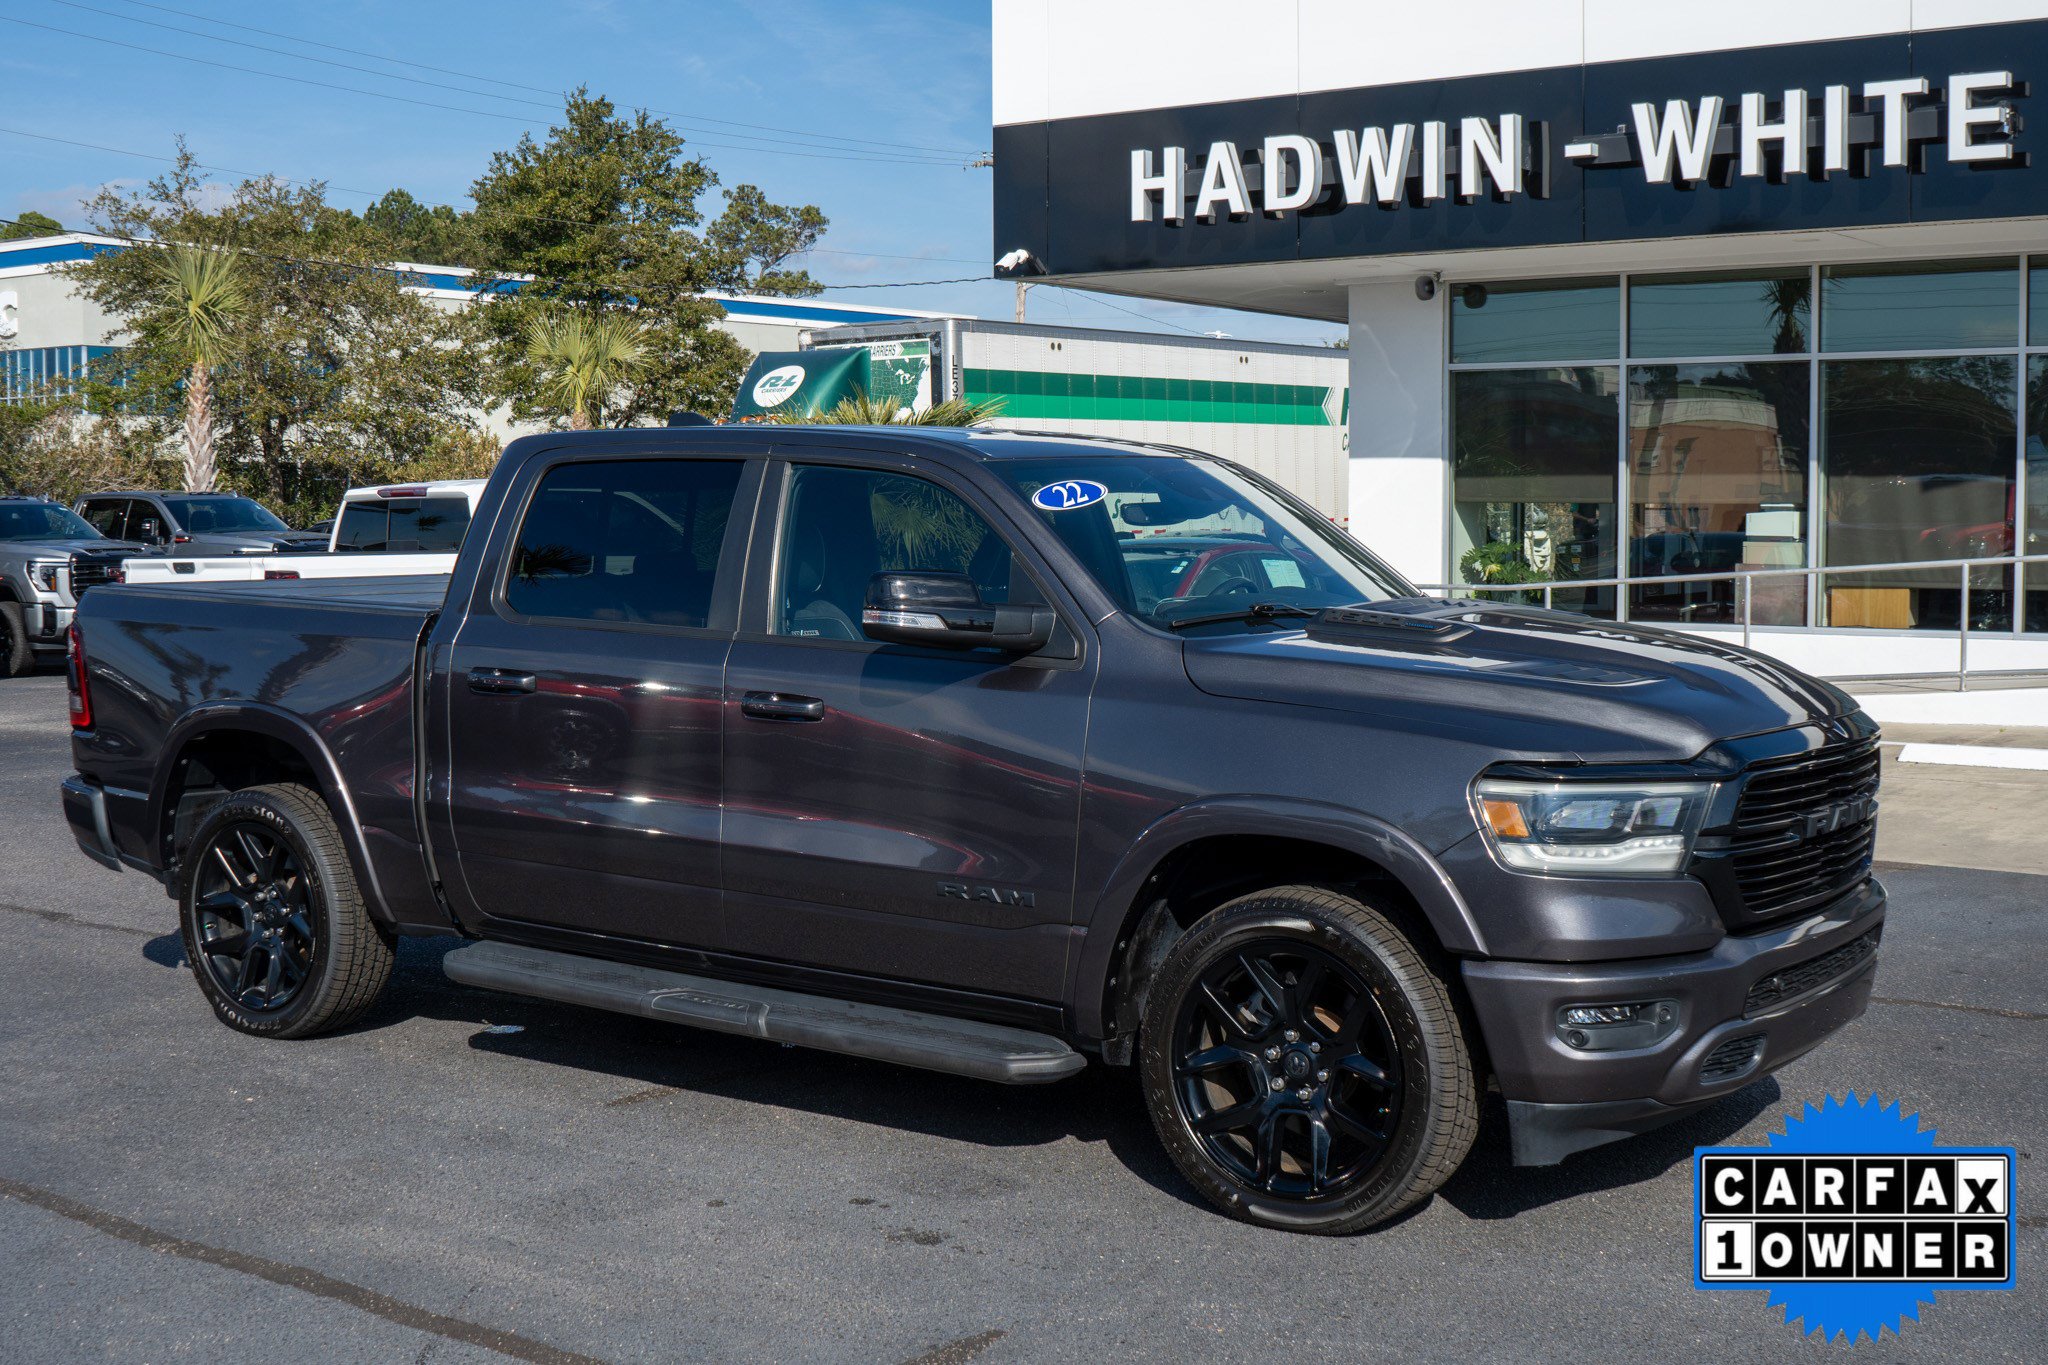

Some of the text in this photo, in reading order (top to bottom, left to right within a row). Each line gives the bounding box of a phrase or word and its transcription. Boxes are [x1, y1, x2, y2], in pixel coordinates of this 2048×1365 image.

[1131, 113, 1522, 223] HADWIN
[1631, 71, 2013, 184] WHITE
[1052, 482, 1089, 508] 22
[1807, 797, 1869, 839] RAM
[937, 882, 1036, 909] RAM
